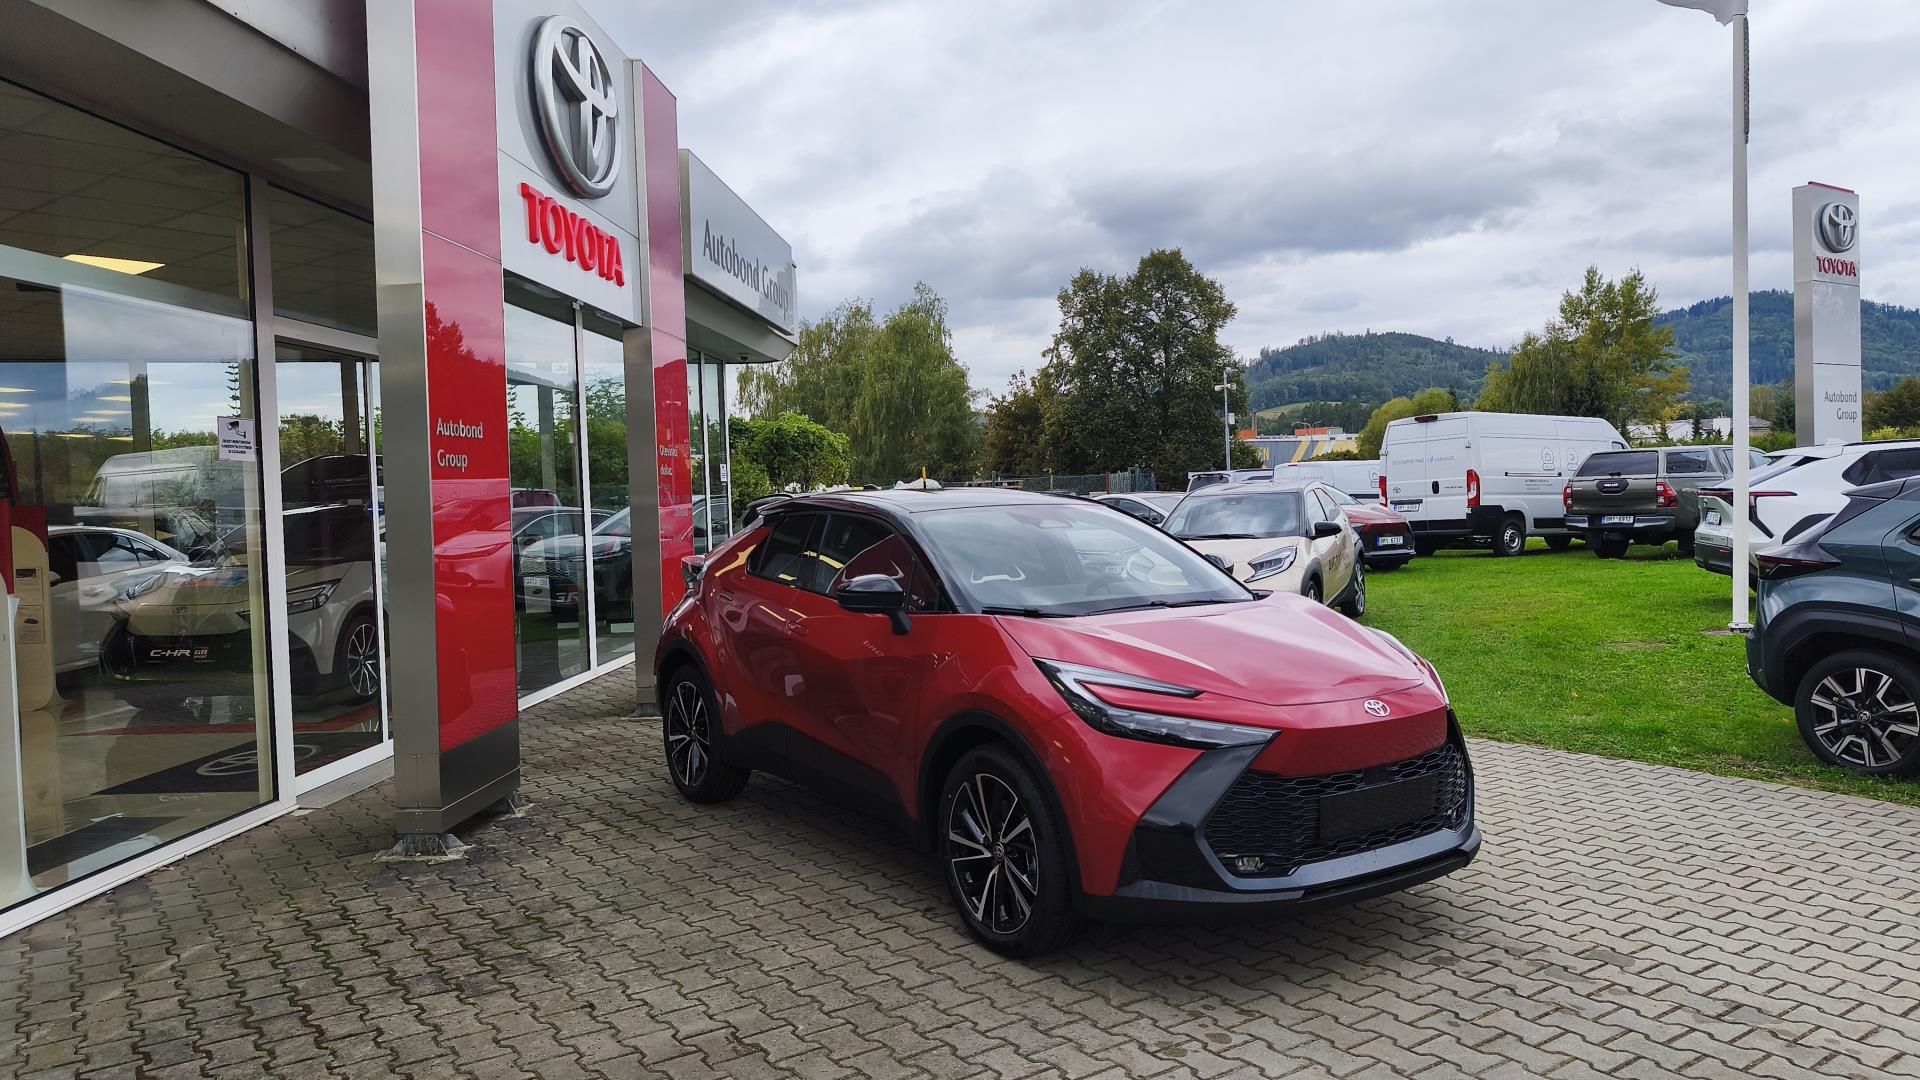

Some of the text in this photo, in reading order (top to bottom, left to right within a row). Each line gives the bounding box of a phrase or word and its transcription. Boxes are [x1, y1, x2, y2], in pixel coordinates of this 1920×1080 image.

[519, 182, 625, 287] TOYOTA
[703, 219, 789, 321] Autobond Group
[1816, 255, 1857, 277] TOYOTA
[1823, 390, 1857, 403] Autobond
[1836, 407, 1857, 423] Group
[436, 417, 484, 439] Autobond
[437, 448, 468, 473] Group
[150, 649, 192, 657] C-HR
